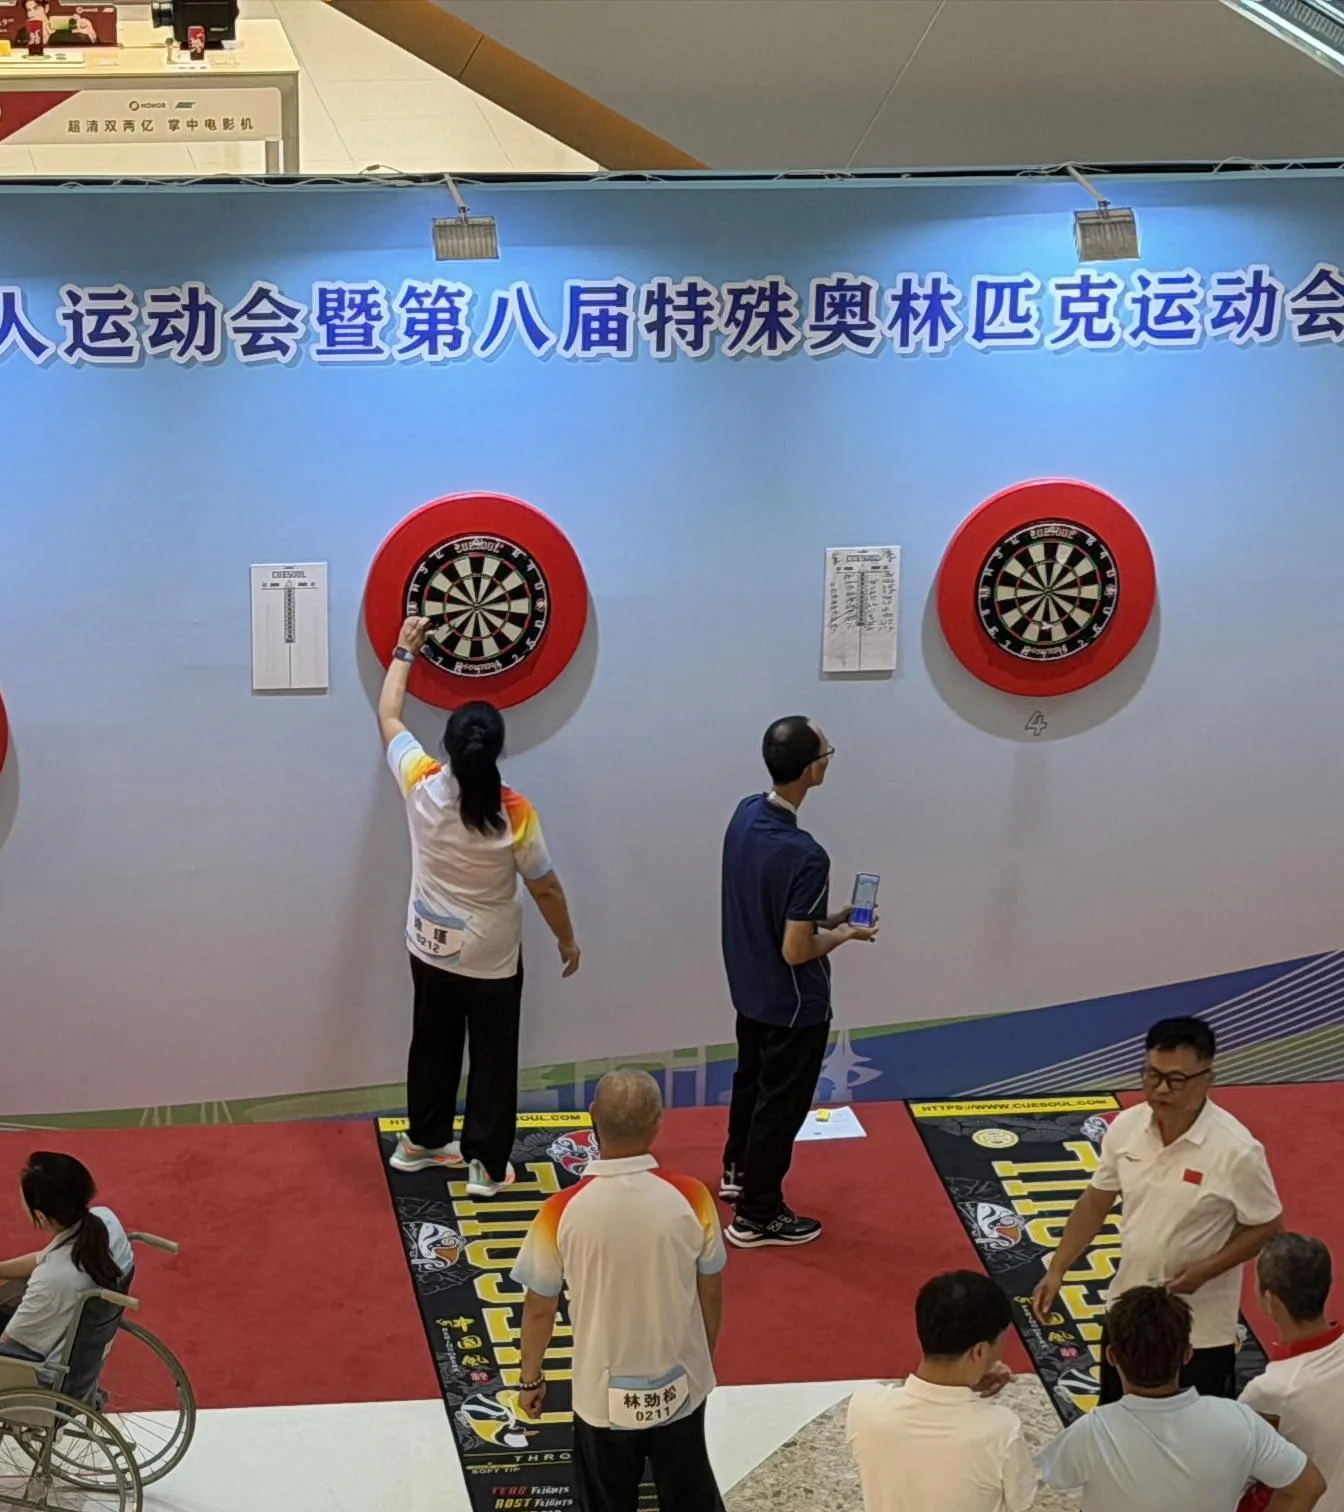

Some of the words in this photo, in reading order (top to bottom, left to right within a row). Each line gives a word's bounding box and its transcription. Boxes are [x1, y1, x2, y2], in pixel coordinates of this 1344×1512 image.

[67, 118, 154, 133] 超清双两亿
[167, 116, 254, 132] 掌中电影机
[1025, 710, 1048, 737] 4
[623, 1385, 677, 1409] 林劲松
[635, 1406, 670, 1421] 0211
[514, 1453, 572, 1463] THRO
